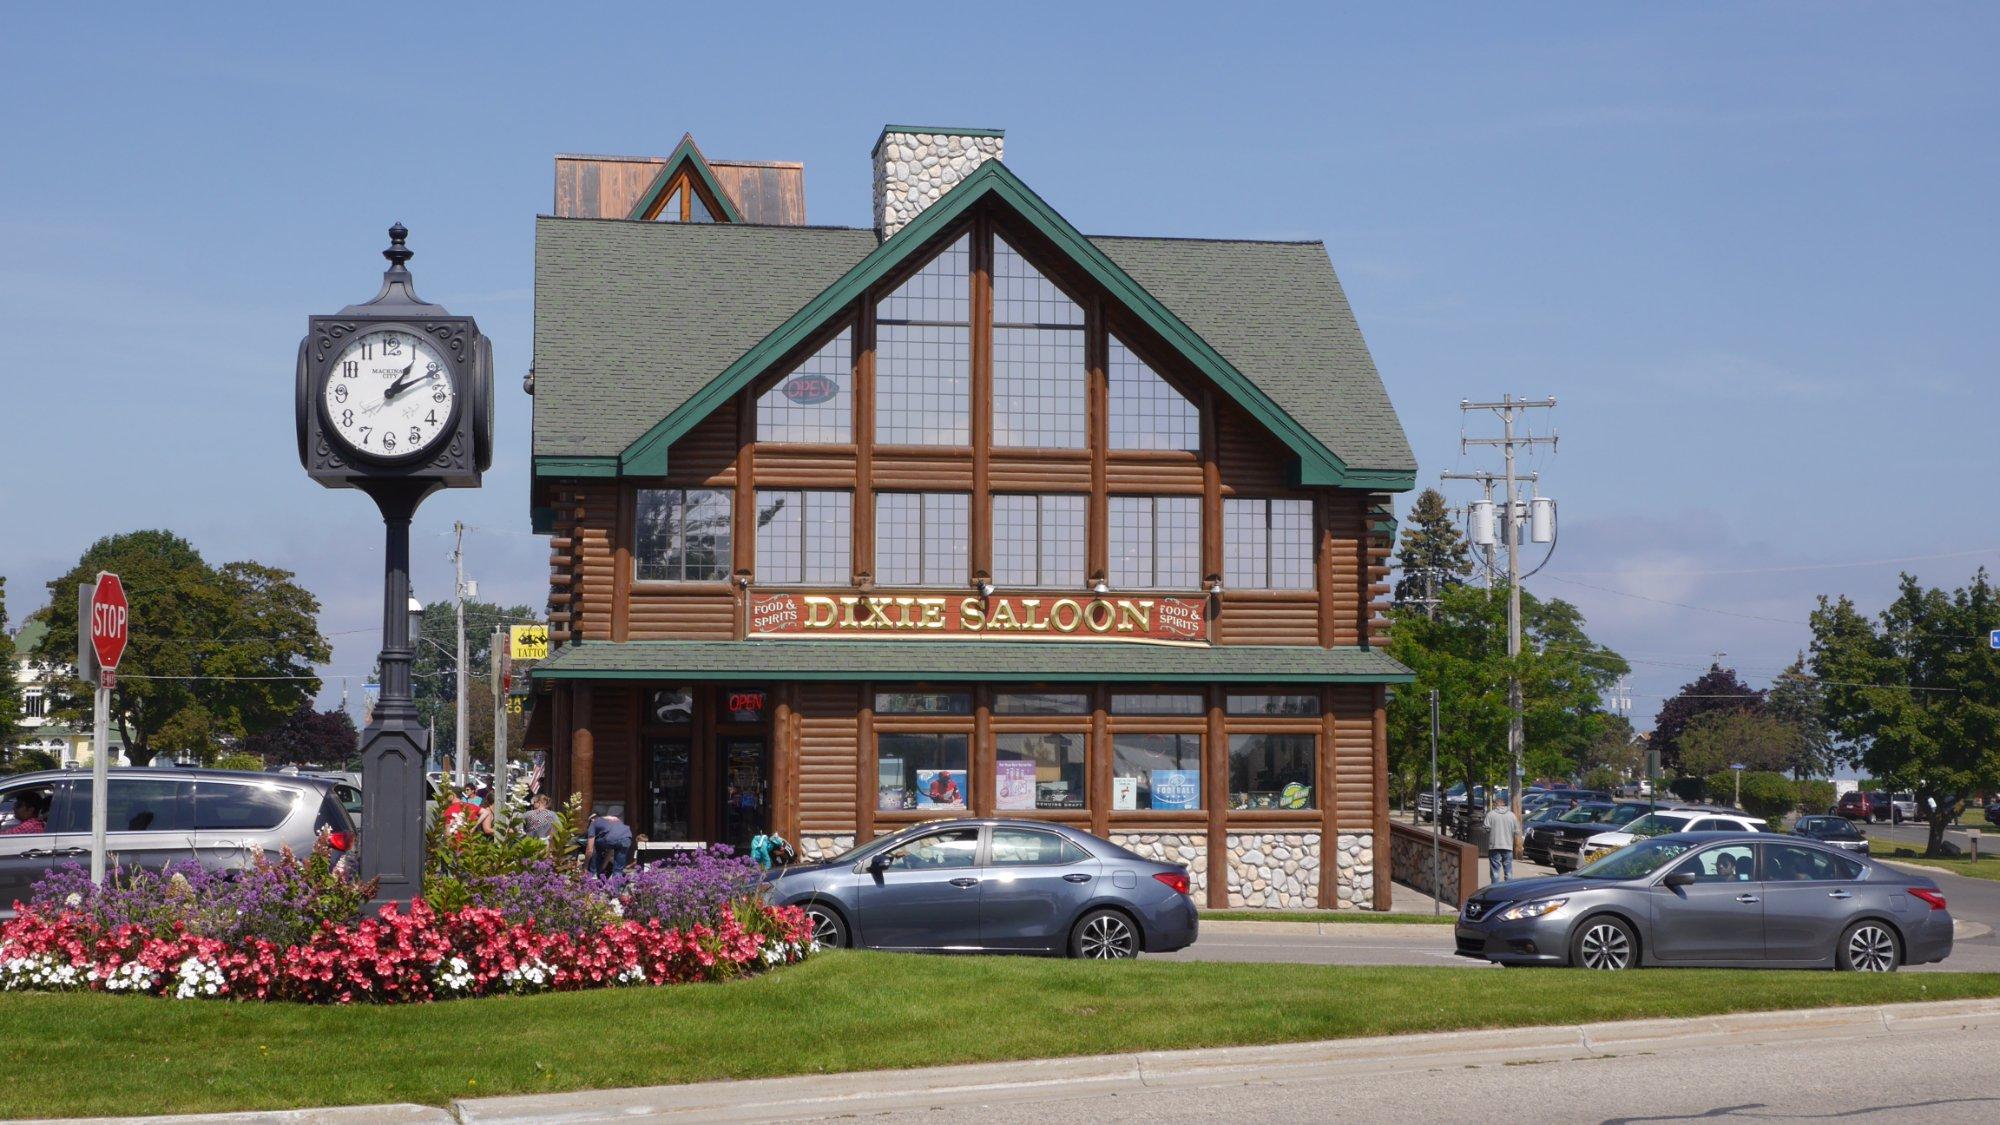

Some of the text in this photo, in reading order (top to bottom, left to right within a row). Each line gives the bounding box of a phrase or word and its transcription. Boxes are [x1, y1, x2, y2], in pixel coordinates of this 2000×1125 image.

[362, 343, 373, 360] 11
[383, 338, 402, 356] 12
[343, 361, 358, 378] 10
[335, 384, 349, 403] 9
[432, 384, 447, 403] 3
[788, 380, 830, 398] OPEN
[342, 409, 353, 427] 8
[424, 409, 438, 426] 4
[359, 426, 373, 444] 7
[383, 431, 396, 450] 6
[408, 426, 421, 444] 5
[754, 599, 796, 615] FOOD &
[803, 596, 1155, 632] DIXIE SALOON
[1160, 604, 1201, 620] FOOD &
[94, 602, 126, 638] STOP
[754, 611, 797, 627] SPIRITS
[1159, 614, 1199, 631] SPIRITS
[729, 694, 764, 712] OPEN
